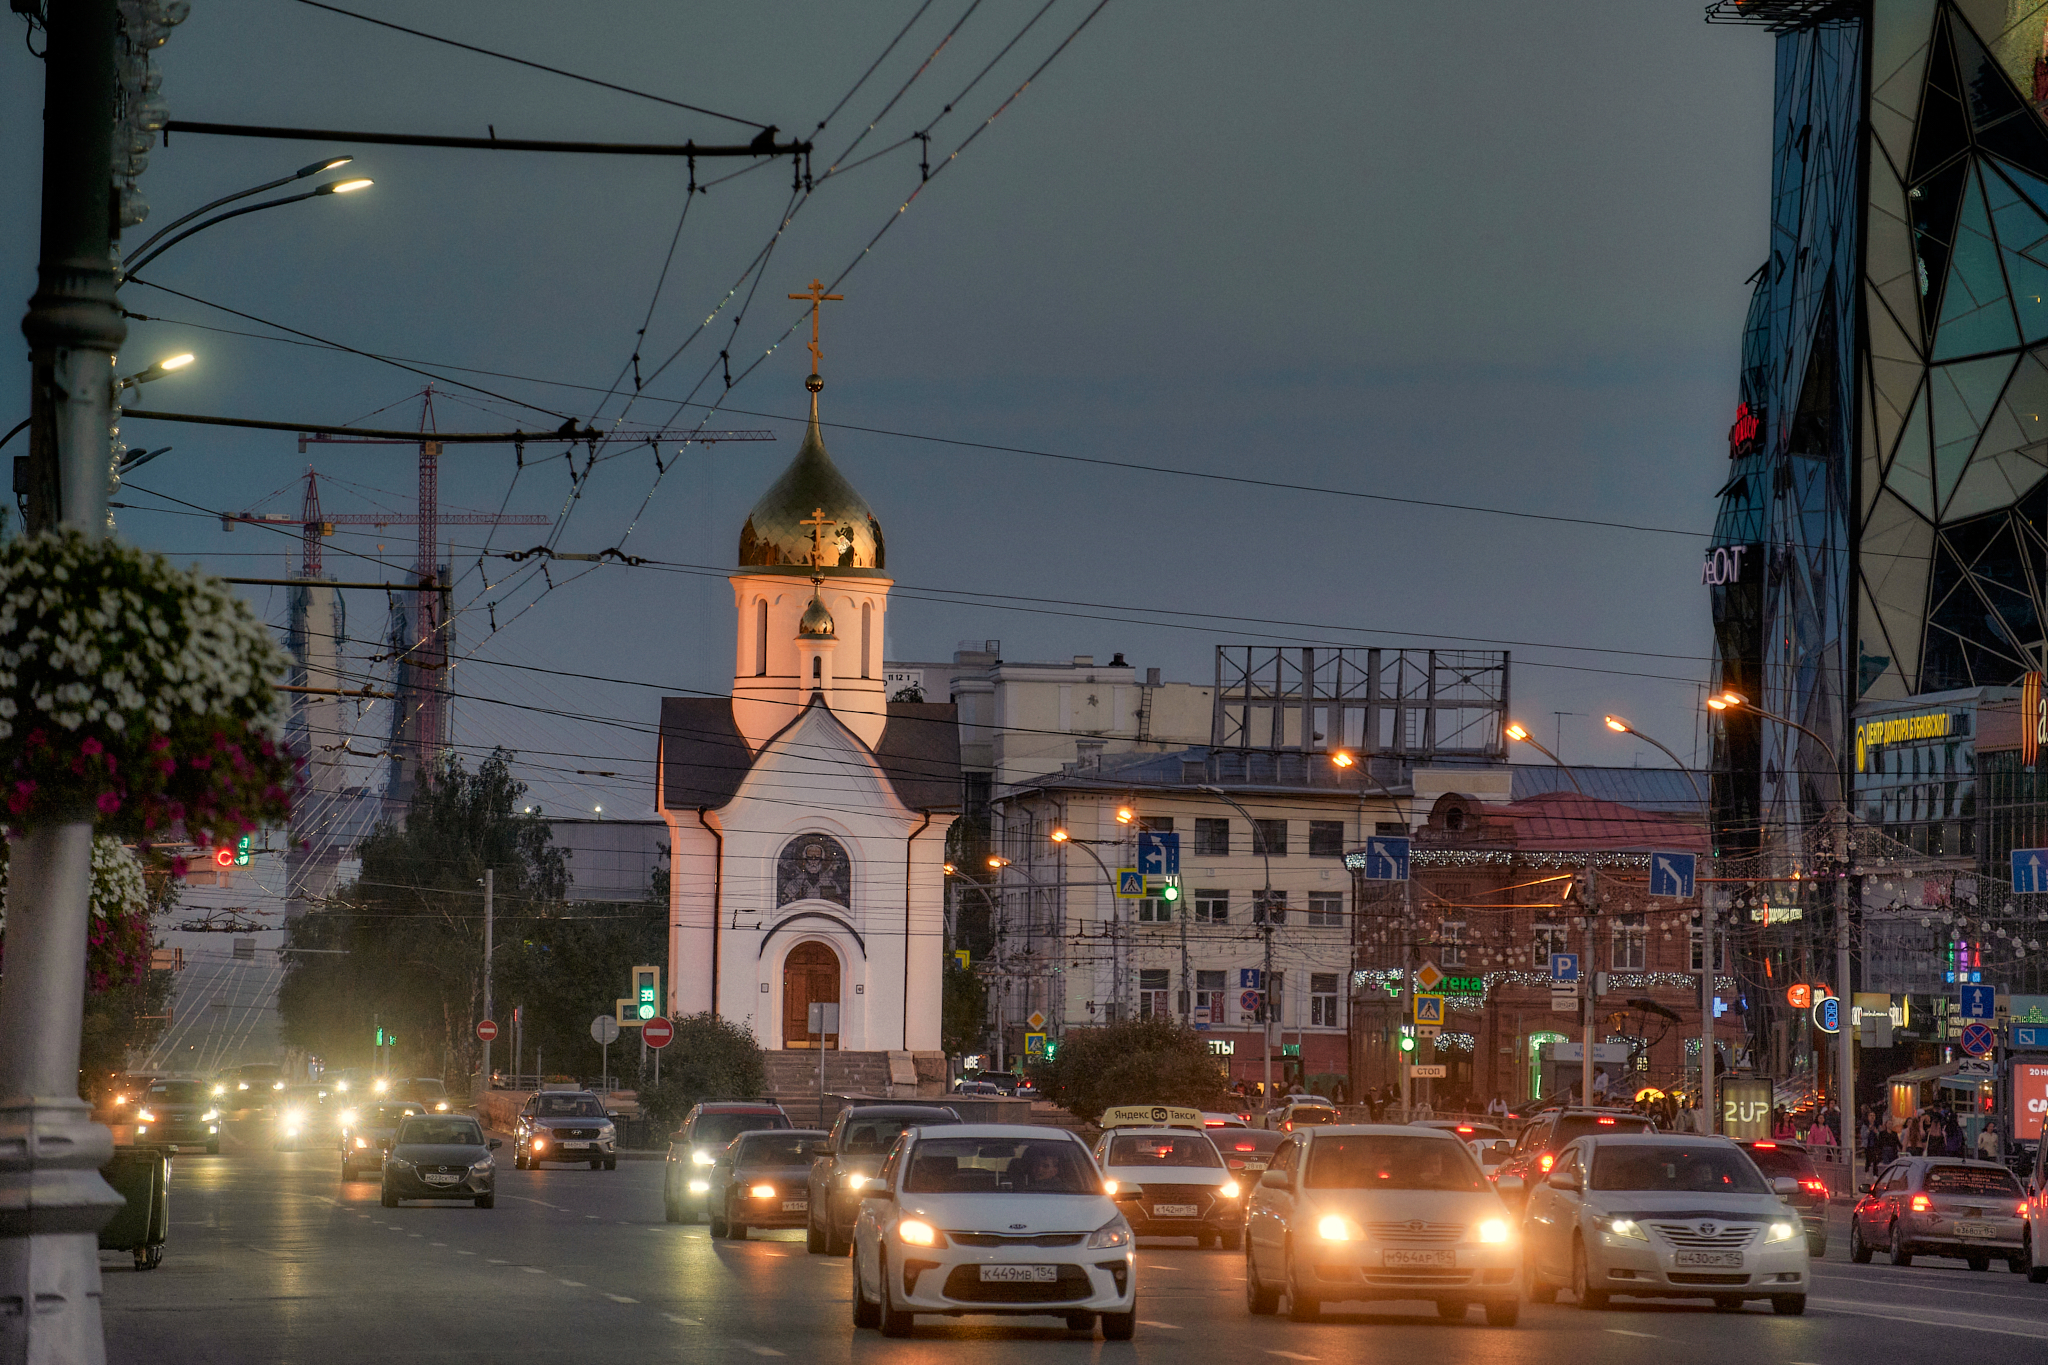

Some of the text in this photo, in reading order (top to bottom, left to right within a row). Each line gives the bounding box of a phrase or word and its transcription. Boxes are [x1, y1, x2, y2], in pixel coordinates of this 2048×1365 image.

[1867, 722, 1884, 746] ЦЕНТР
[1884, 717, 1909, 747] ДОКТОРА
[1557, 957, 1572, 977] P
[1401, 1026, 1415, 1038] 41
[1417, 1067, 1440, 1076] СТОП
[2029, 1068, 2040, 1076] 20
[1114, 1109, 1196, 1121] Яндекс Go Такси
[984, 1267, 1053, 1280] К449МВ 154
